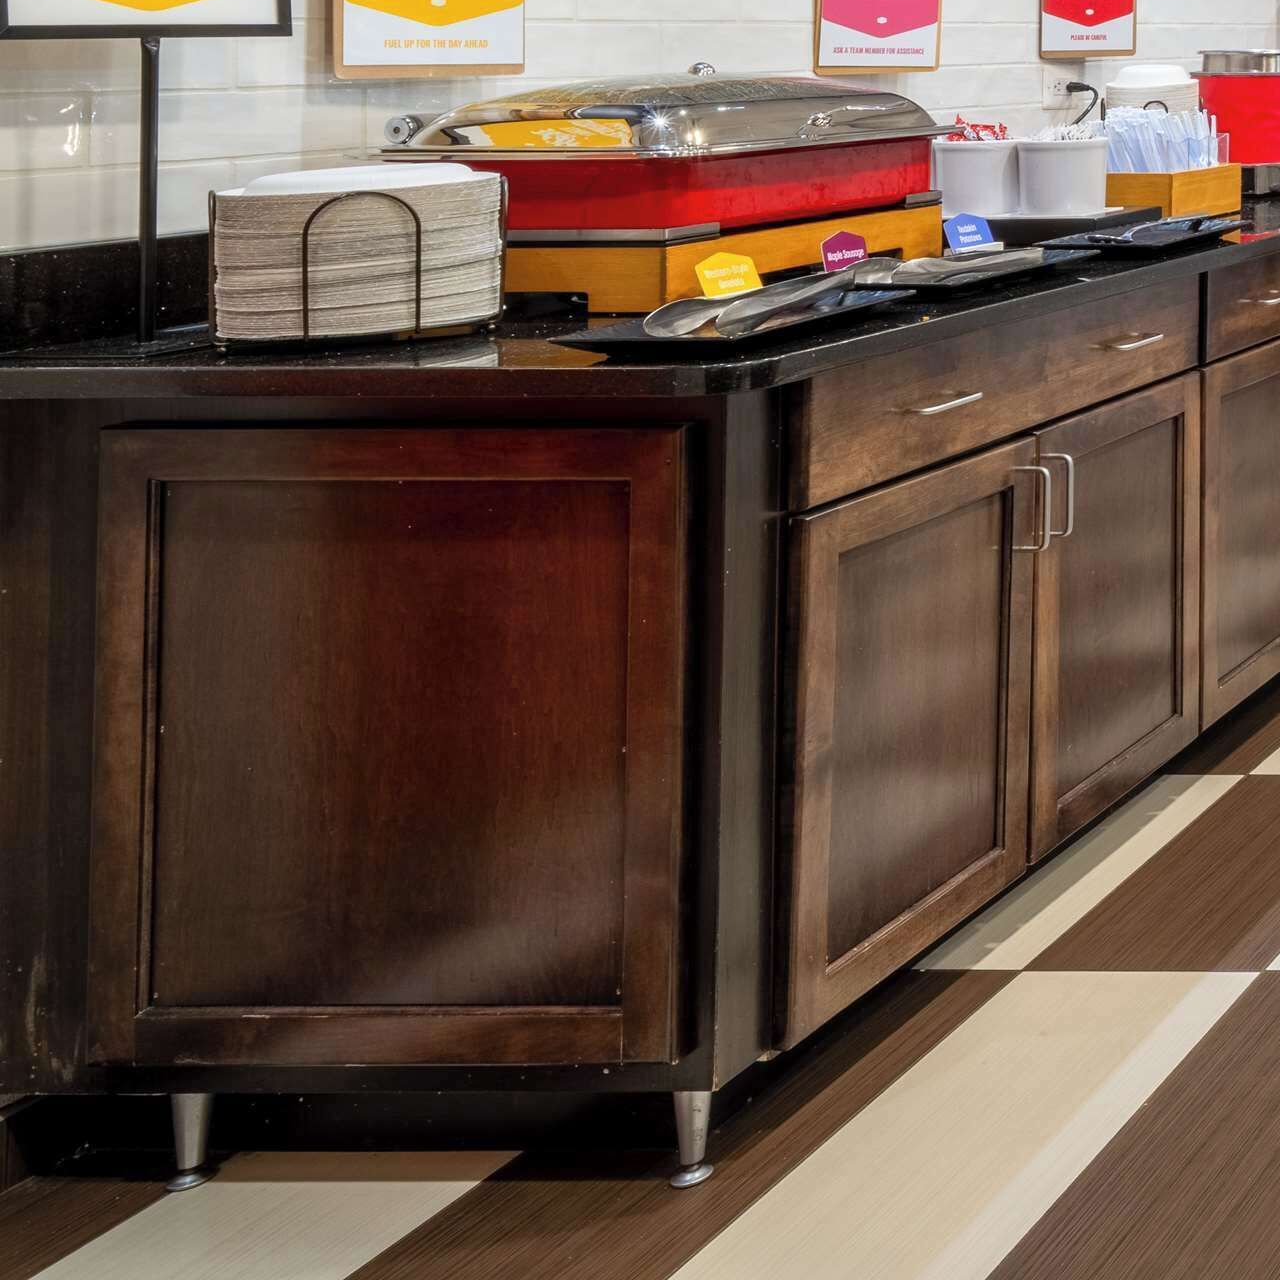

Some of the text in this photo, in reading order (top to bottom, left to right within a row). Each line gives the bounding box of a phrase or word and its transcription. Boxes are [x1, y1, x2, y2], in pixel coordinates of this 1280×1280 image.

[384, 39, 489, 48] FUEL UP FOR THE DAY AHEAD
[833, 46, 843, 54] ASK
[864, 47, 885, 55] MEMBER
[886, 47, 895, 55] FOR
[827, 248, 864, 262] Maple Sausage
